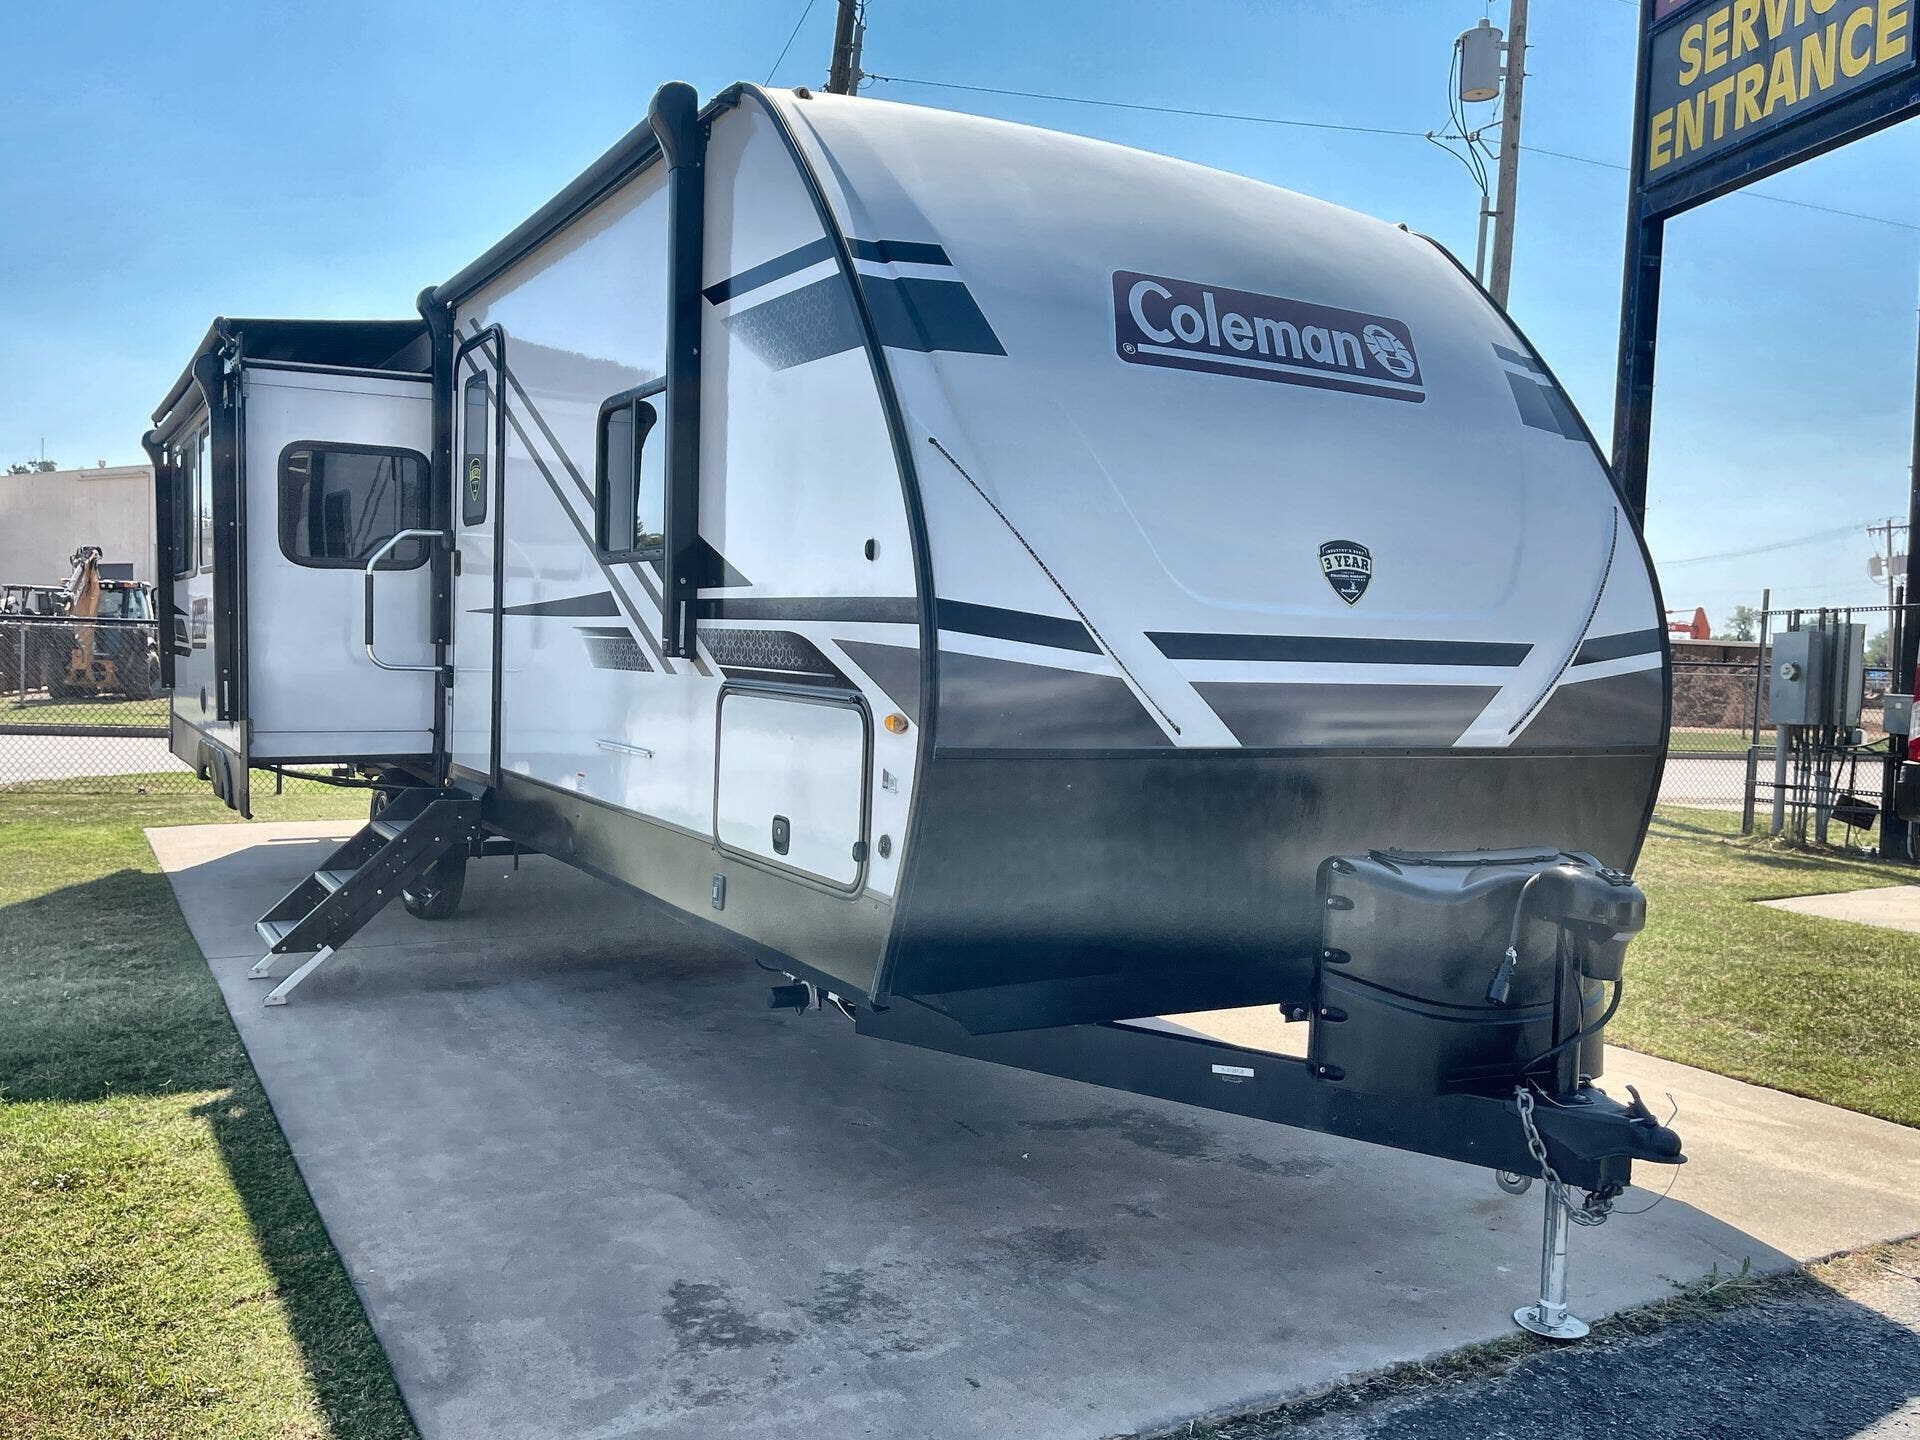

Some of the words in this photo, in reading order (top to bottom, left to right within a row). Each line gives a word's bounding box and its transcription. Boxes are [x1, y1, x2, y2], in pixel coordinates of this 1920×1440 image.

[1649, 0, 1908, 171] ENTRANCE
[1679, 0, 1837, 86] SERV
[1128, 281, 1366, 369] Coleman
[1324, 557, 1333, 570] 3
[1335, 555, 1369, 571] YEAR
